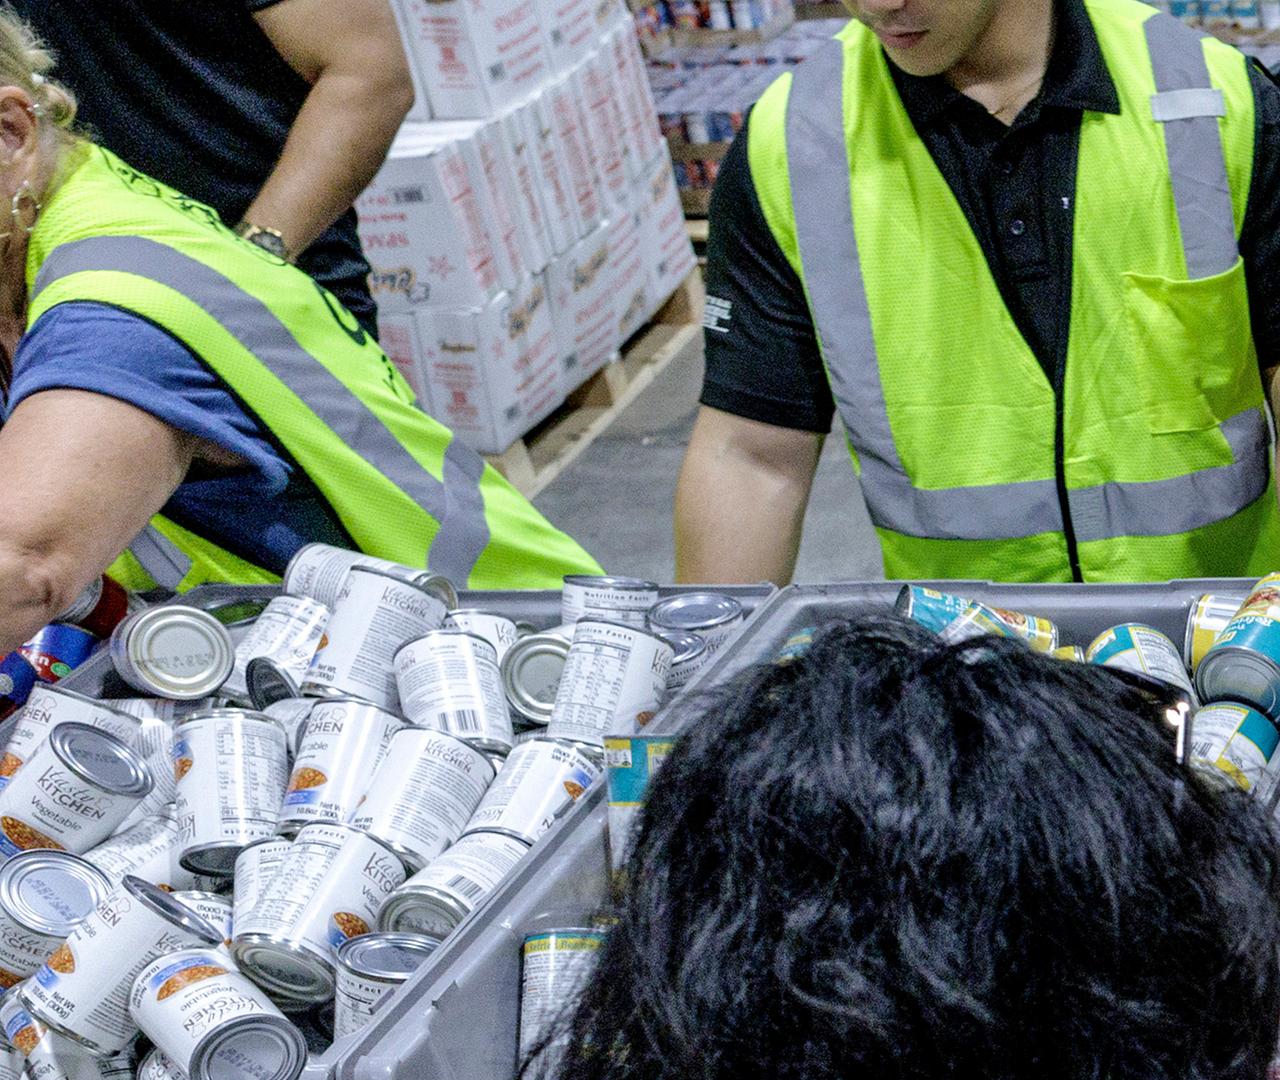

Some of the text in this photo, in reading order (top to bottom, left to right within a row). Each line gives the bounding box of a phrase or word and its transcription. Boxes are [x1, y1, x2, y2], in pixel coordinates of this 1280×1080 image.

[381, 591, 426, 618] KITCHEN
[584, 591, 626, 600] Nutrition
[606, 630, 633, 641] Facts
[307, 721, 344, 734] CHEN
[424, 742, 472, 774] KITCHEN
[37, 770, 106, 820] KITCHEN
[31, 795, 82, 832] Vegetable
[317, 829, 345, 840] Facts
[363, 855, 395, 894] KITC
[359, 983, 382, 995] Fact
[46, 999, 70, 1019] (300g)
[52, 991, 76, 1012] Net Wt.
[183, 996, 262, 1032] KITCHEN
